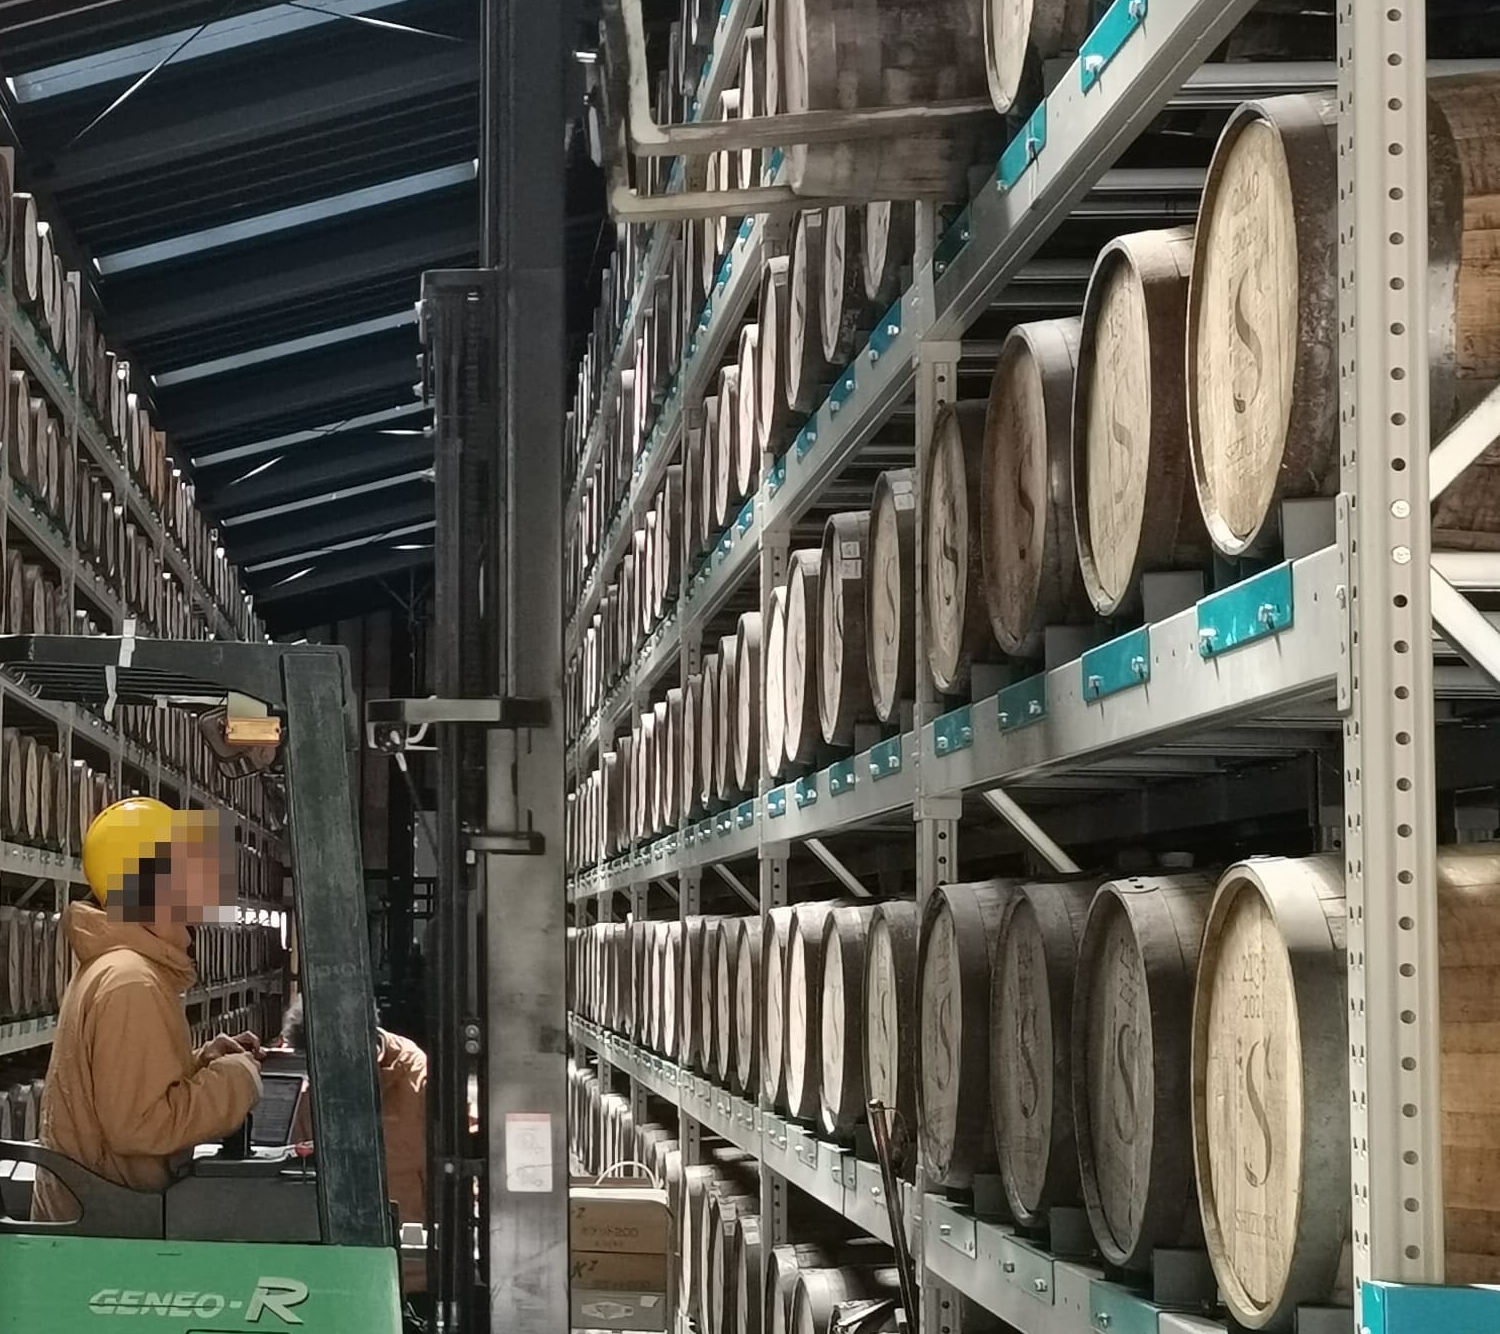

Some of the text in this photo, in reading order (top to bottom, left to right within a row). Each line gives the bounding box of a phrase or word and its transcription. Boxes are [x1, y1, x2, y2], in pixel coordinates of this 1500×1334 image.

[1230, 265, 1267, 415] S
[931, 988, 953, 1092] S
[1018, 1004, 1039, 1121] S
[1112, 1021, 1142, 1146] S
[1243, 1031, 1274, 1187] S
